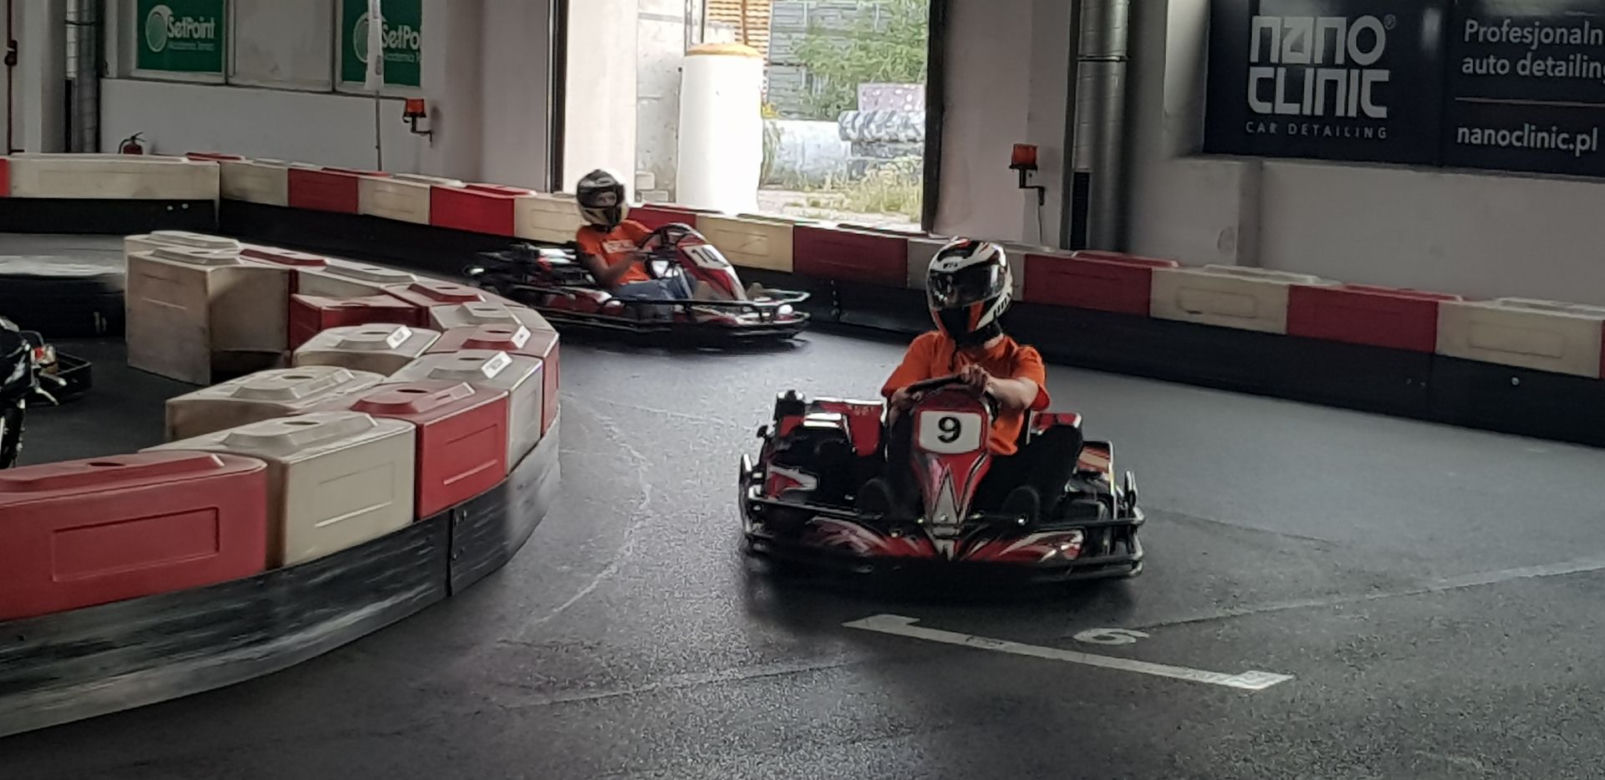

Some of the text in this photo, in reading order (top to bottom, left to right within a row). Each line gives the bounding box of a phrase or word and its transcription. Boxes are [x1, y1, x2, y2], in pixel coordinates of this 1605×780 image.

[167, 16, 215, 39] SetPoint
[1464, 19, 1604, 50] Profesjonaln
[1462, 55, 1510, 75] auto
[1246, 121, 1387, 139] CAR DETAILING
[1457, 123, 1598, 157] nanoclinic.pl
[937, 416, 961, 443] 9
